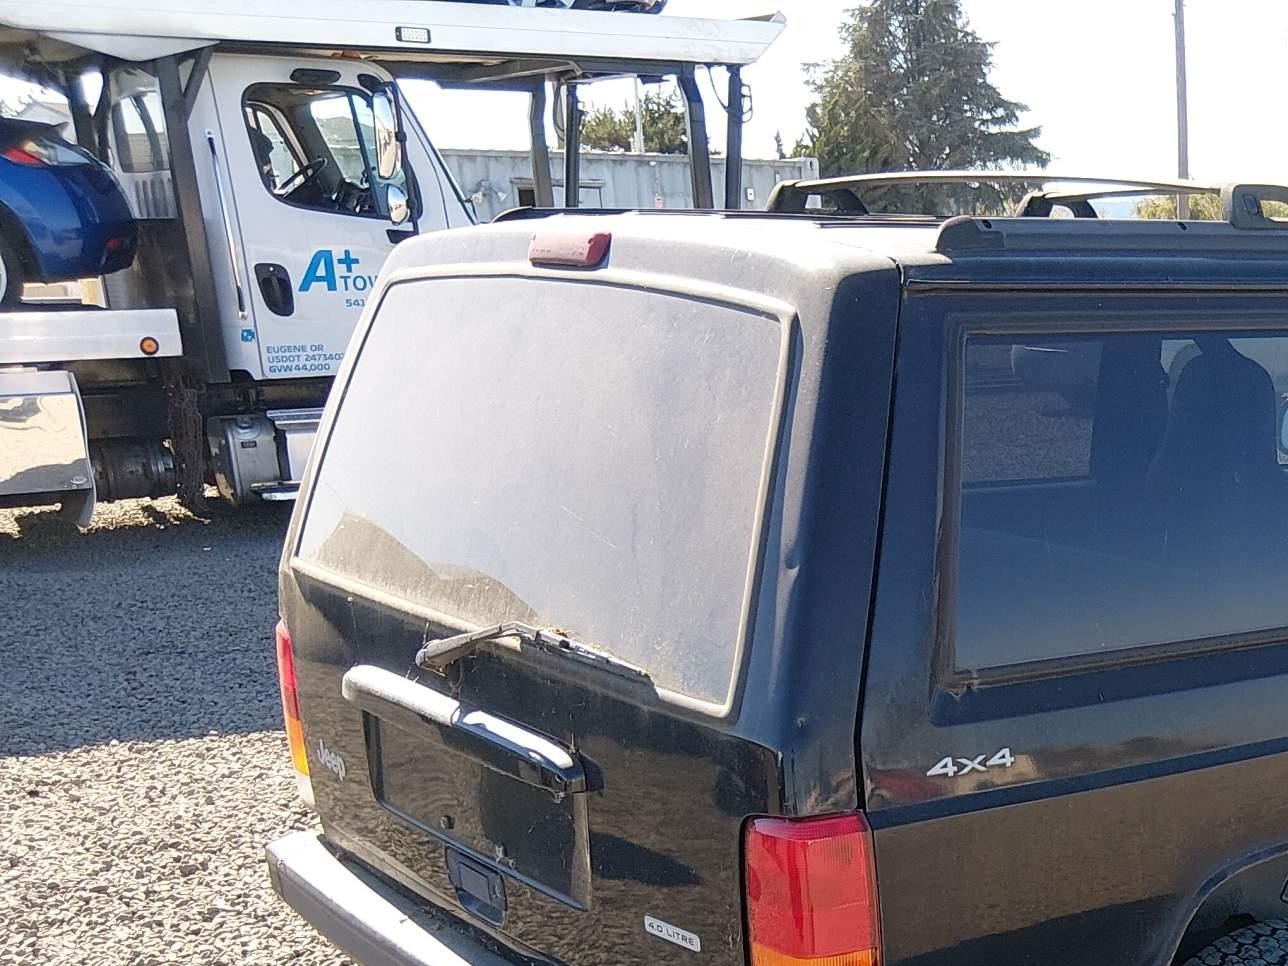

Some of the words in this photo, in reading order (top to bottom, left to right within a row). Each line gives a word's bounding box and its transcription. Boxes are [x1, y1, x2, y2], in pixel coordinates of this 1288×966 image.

[298, 249, 359, 292] A+
[266, 344, 308, 354] EUGENE
[310, 344, 324, 352] OR
[268, 354, 302, 364] USDOT
[316, 738, 346, 782] Jeep
[666, 927, 695, 946] LITRE
